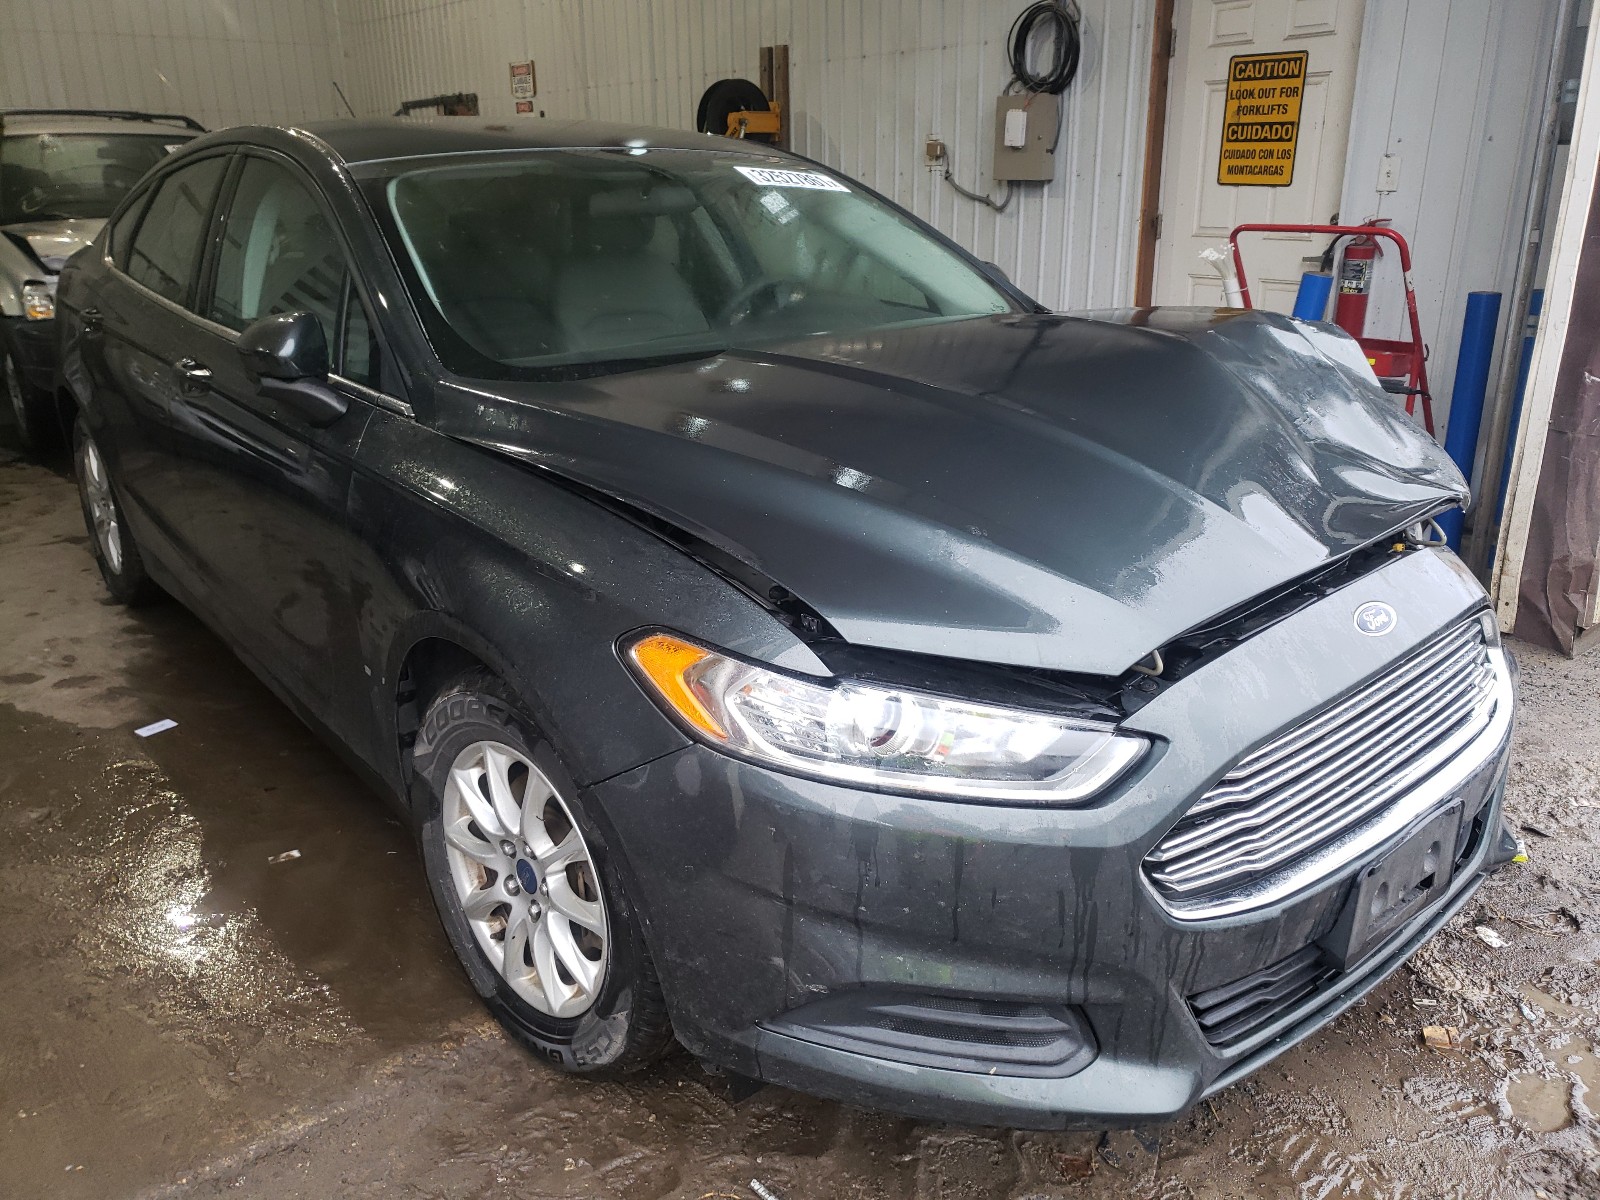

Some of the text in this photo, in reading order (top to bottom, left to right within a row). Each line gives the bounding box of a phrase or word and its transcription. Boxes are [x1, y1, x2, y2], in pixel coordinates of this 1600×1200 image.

[1235, 60, 1301, 79] CAUTION
[1230, 86, 1299, 101] LOOK OUT FOR
[1236, 104, 1288, 116] FORKLIFTS
[1228, 124, 1293, 140] CUIDADO
[1223, 149, 1292, 160] CUIDADO CON LOS
[1227, 165, 1284, 176] MONTACARGAS
